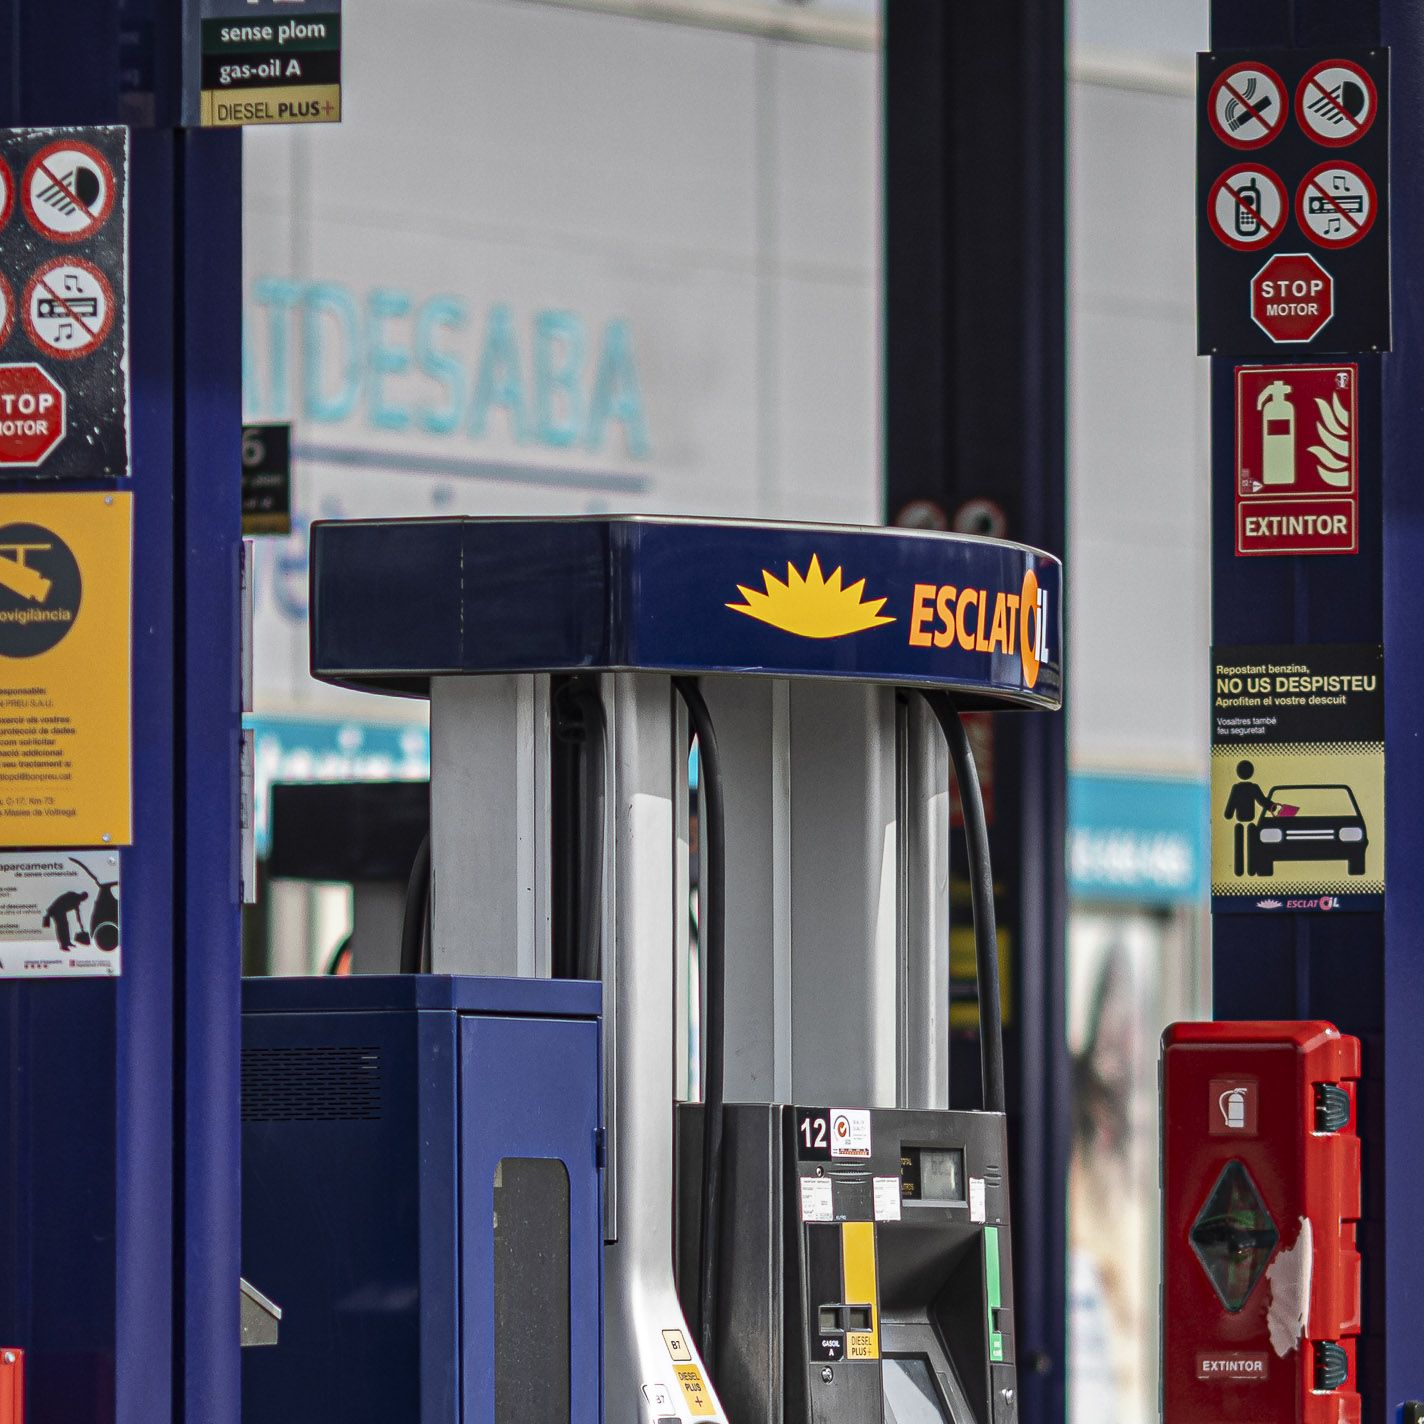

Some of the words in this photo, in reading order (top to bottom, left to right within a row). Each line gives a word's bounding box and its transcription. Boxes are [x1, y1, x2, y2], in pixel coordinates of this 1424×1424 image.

[220, 26, 273, 42] sense
[278, 20, 327, 45] plom
[219, 58, 281, 84] gas-oil
[285, 59, 302, 76] A
[217, 102, 273, 121] DIESEL
[1261, 280, 1324, 298] STOP
[1266, 303, 1319, 316] MOTOR
[1245, 514, 1348, 537] EXTINTOR
[1216, 665, 1266, 676] Repostant
[1268, 664, 1310, 674] benzina,
[1216, 678, 1243, 694] NO
[1247, 677, 1272, 693] US
[1275, 675, 1377, 692] DESPISTEU
[1215, 696, 1262, 708] Aprofiten
[1263, 696, 1273, 705] el
[1275, 696, 1307, 706] vostre
[1308, 695, 1347, 705] descuit
[800, 1117, 828, 1149] 12
[851, 1335, 872, 1346] DIESEL
[1202, 1360, 1263, 1372] EXTINTOR
[684, 1383, 702, 1392] PLUS
